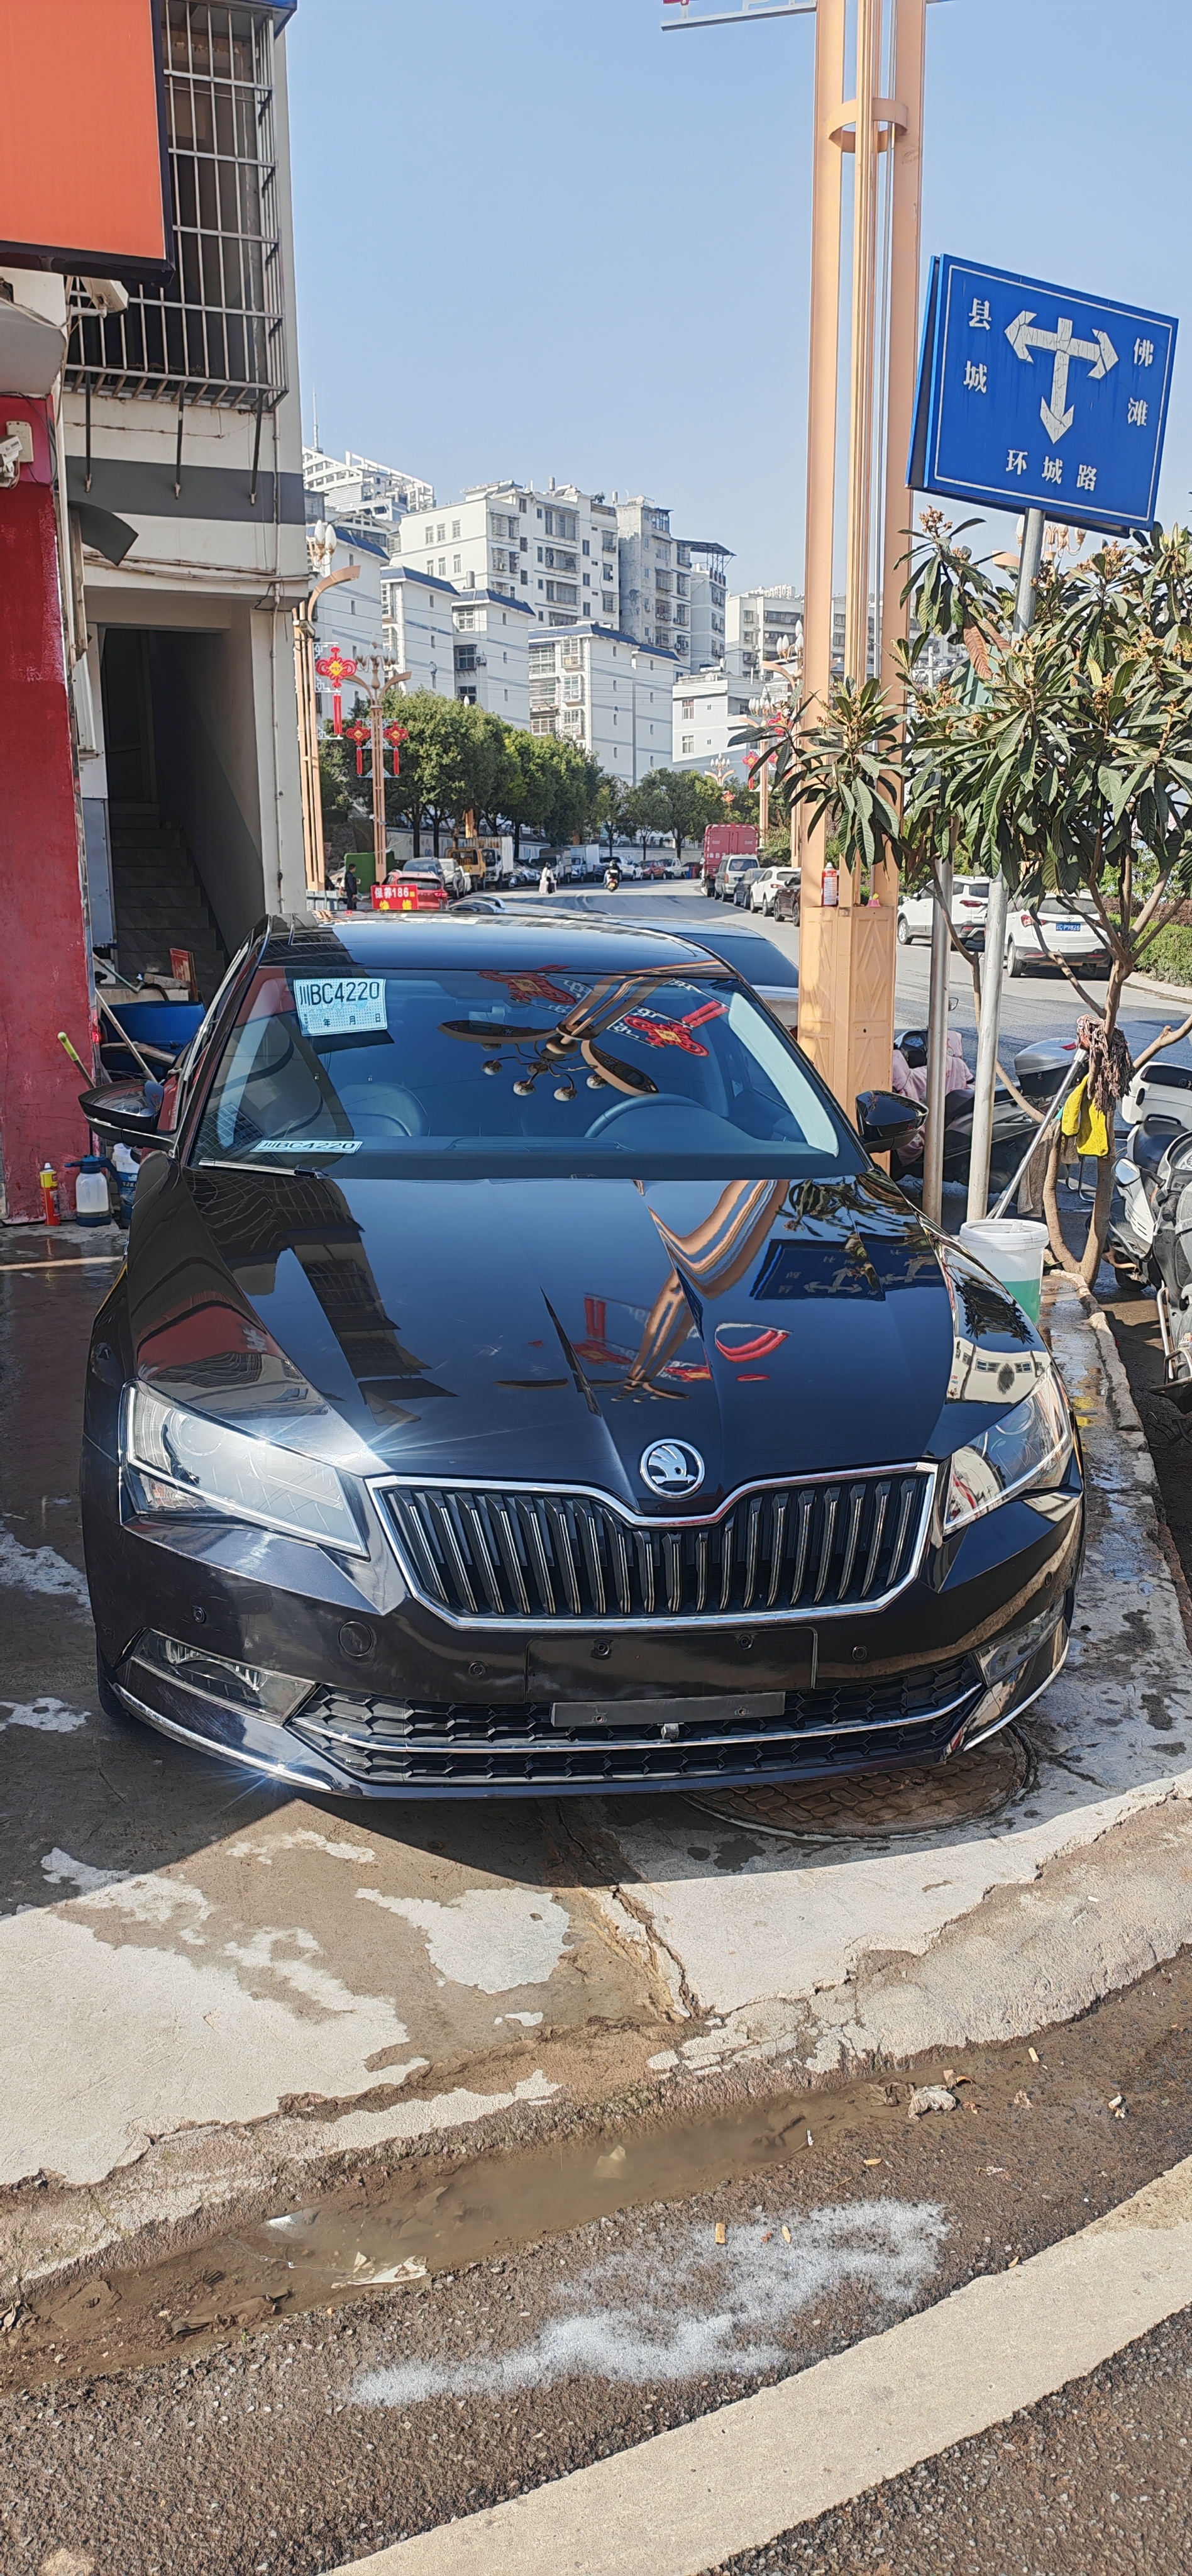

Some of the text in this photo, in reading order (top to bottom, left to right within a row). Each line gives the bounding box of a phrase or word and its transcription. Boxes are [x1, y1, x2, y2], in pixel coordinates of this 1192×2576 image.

[963, 297, 992, 394] 县城
[1127, 337, 1155, 427] 佛滩
[1005, 449, 1098, 492] 环城路
[299, 981, 380, 1006] 川BC4220
[323, 1013, 381, 1027] 年 月 日
[262, 1141, 355, 1150] 川BC4220
